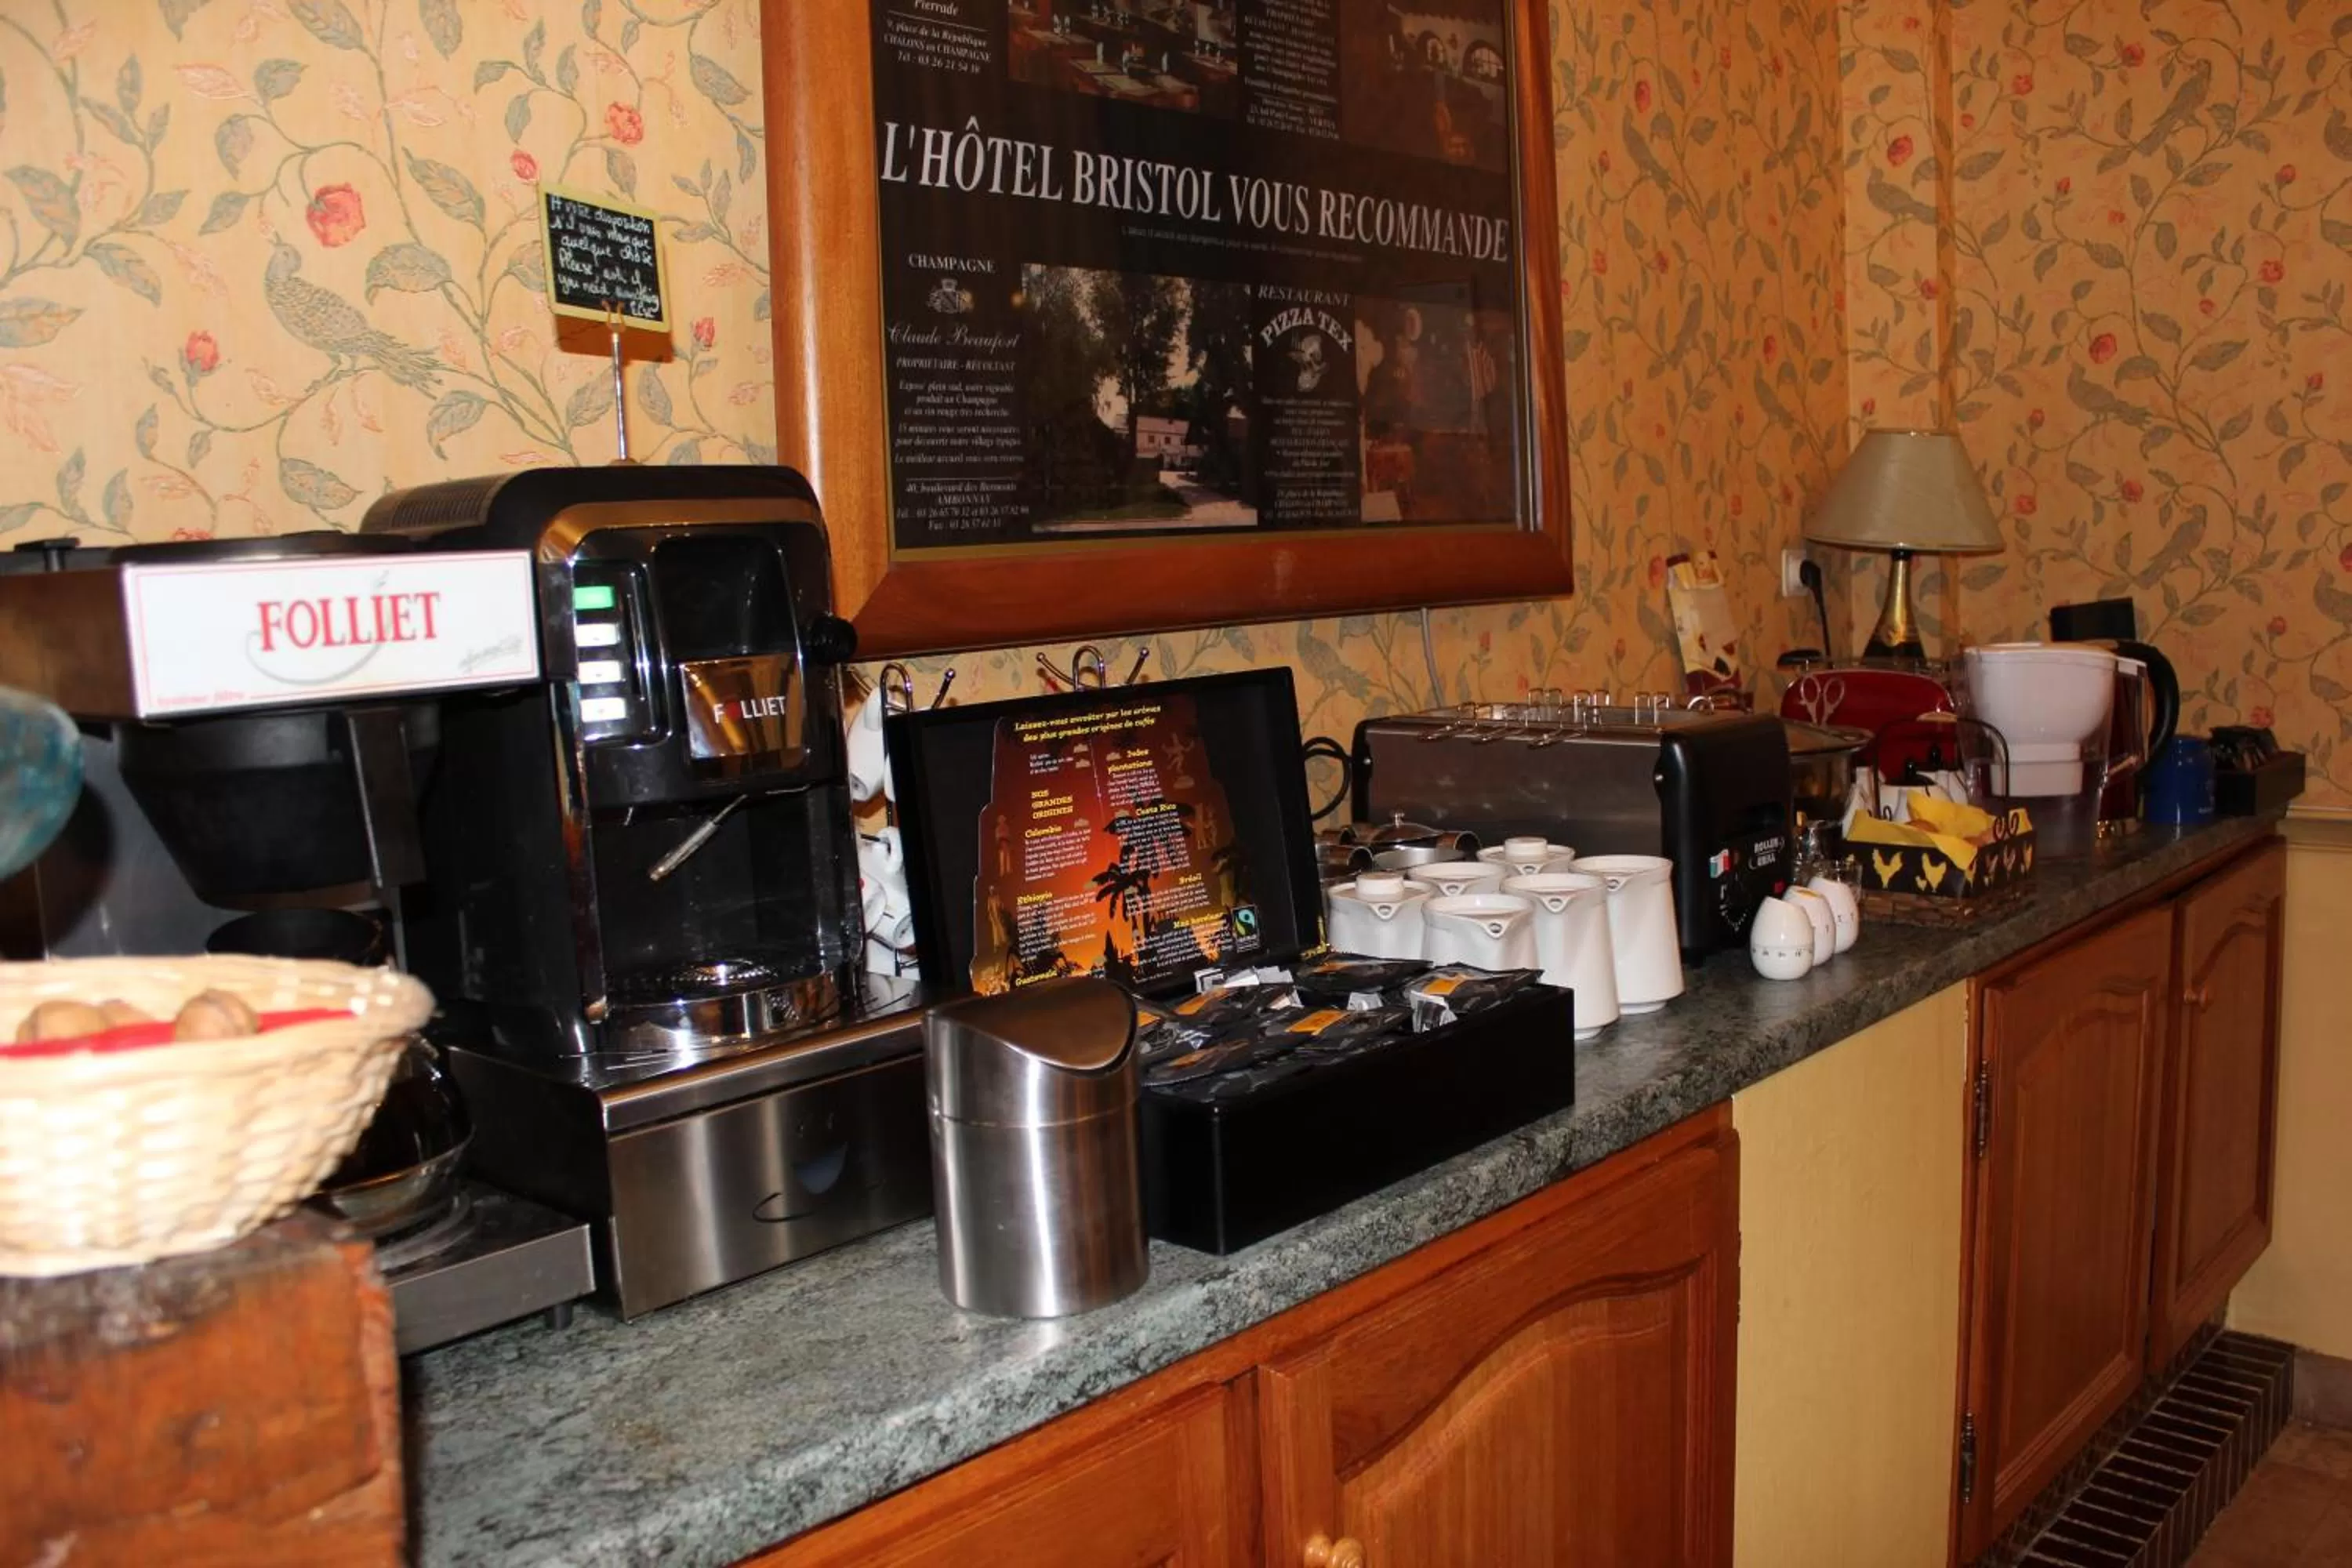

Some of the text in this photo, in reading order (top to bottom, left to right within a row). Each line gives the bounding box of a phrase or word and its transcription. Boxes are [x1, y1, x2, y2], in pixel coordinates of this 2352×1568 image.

[880, 115, 1062, 201] L'HÔTEL
[1073, 150, 1221, 222] BRISTOL
[1229, 174, 1310, 234] VOUS
[1318, 189, 1510, 263] RECOMMANDE
[908, 253, 996, 274] CHAMPAGNE
[1257, 283, 1352, 307] RESTAURANT
[1259, 307, 1354, 353] PIZZA TEX
[256, 590, 440, 652] FOLLIET
[713, 695, 786, 724] FOLLIET
[1031, 795, 1073, 809] GRANDES
[1033, 805, 1073, 819] ORIGINES
